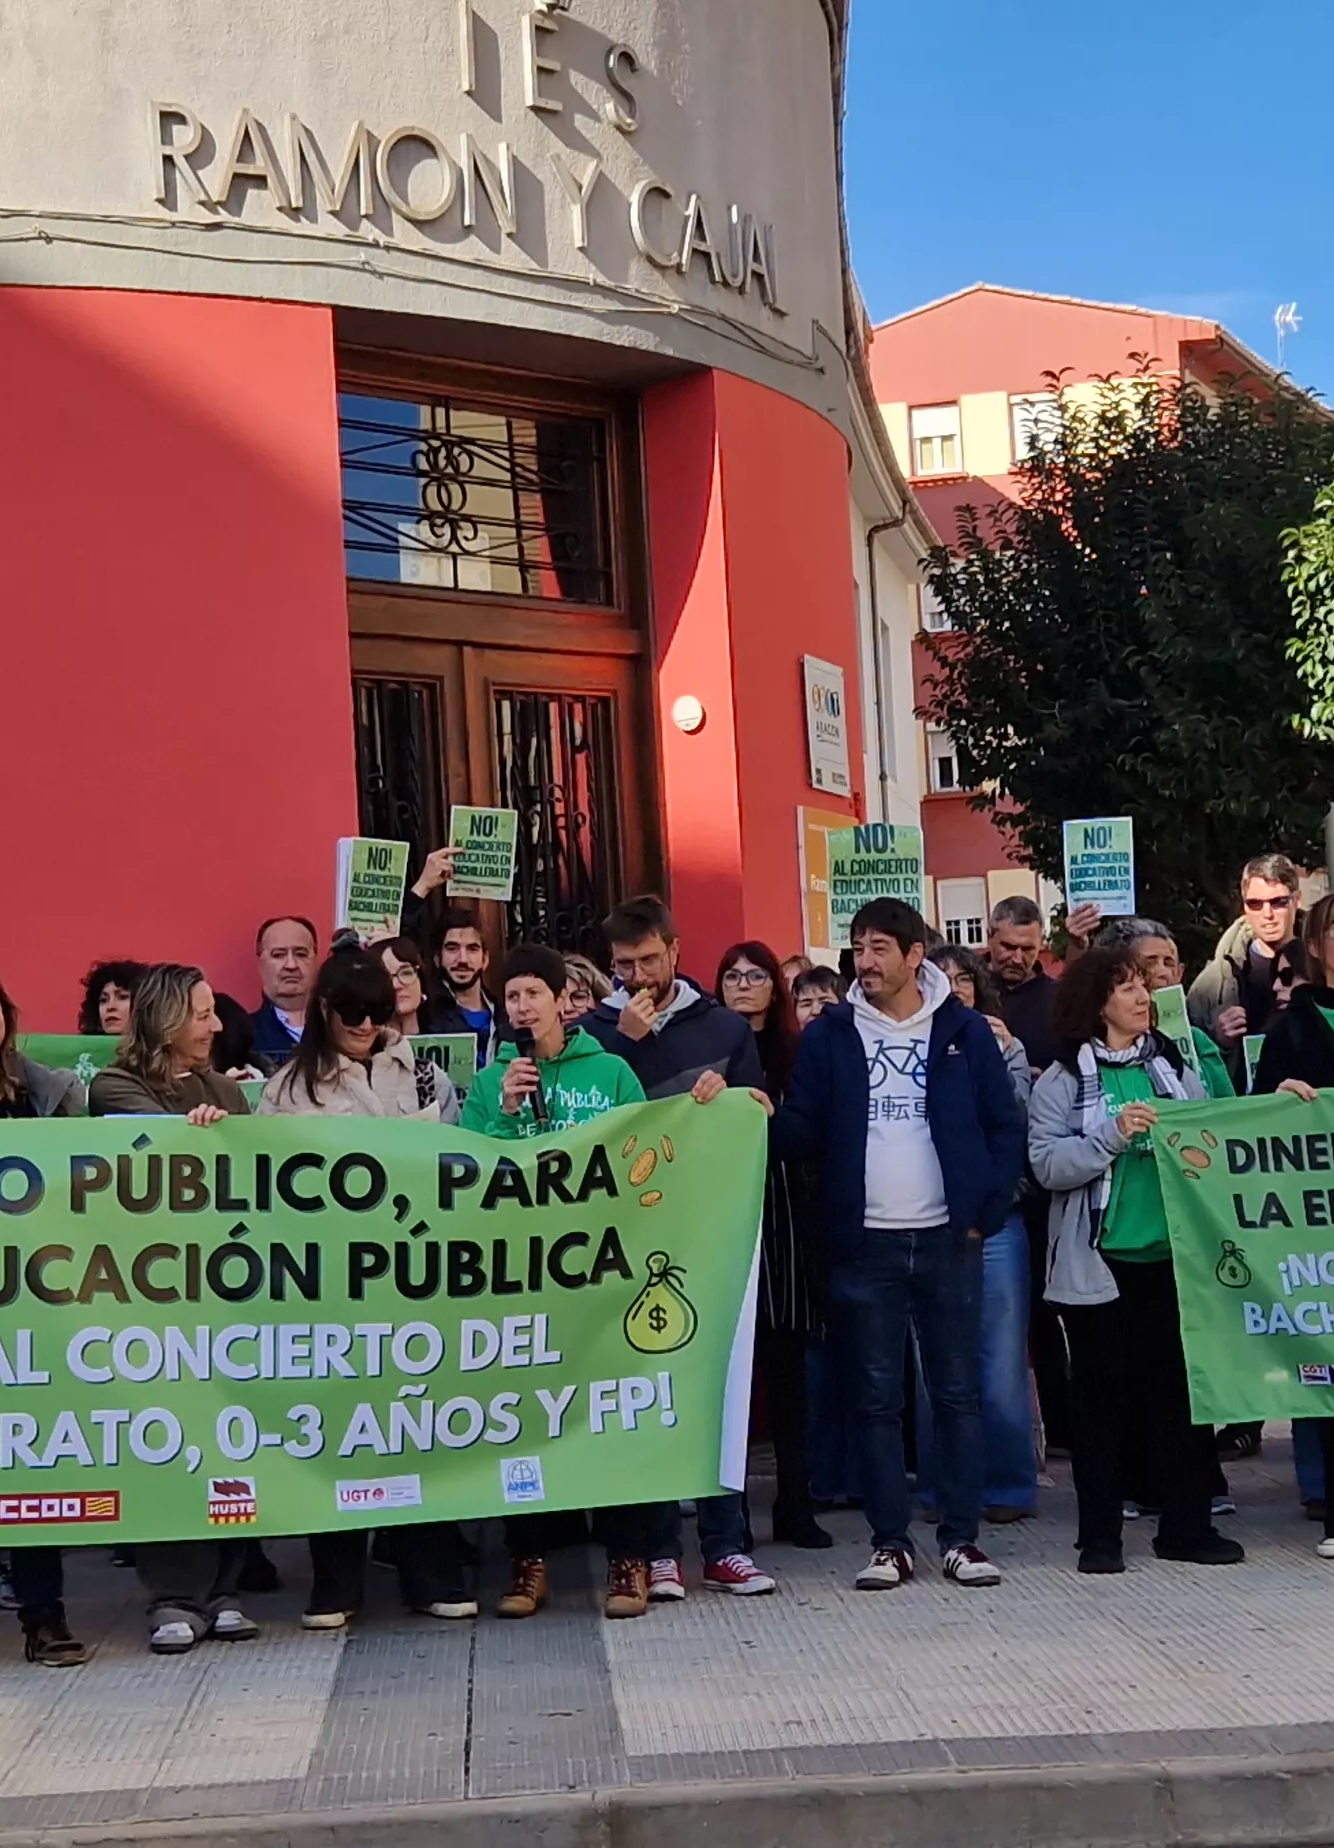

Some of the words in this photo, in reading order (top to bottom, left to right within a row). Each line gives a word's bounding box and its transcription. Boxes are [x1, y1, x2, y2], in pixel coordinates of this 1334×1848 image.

[459, 0, 641, 133] IES
[149, 101, 517, 236] RAMON
[551, 152, 600, 249] Y
[628, 178, 788, 315] CAJAL
[470, 814, 499, 839] NO!
[853, 823, 895, 854] NO!
[1083, 826, 1113, 849] NO!
[367, 846, 393, 872] NO!
[466, 840, 513, 853] CONCIERTO
[1081, 852, 1130, 864] CONCIERTO
[833, 859, 847, 876] AL
[850, 858, 920, 876] CONCIERTO
[833, 878, 901, 895] EDUCATIVO
[903, 877, 920, 894] EN
[69, 1132, 411, 1223] PÚBLICO,
[437, 1143, 619, 1212] PARA
[1233, 1192, 1289, 1229] LA
[348, 1220, 634, 1301] PÚBLICA
[67, 1322, 446, 1384] CONCIERTO
[459, 1313, 562, 1372] DEL
[216, 1403, 325, 1462] 0-3
[336, 1385, 524, 1458] AÑOS
[533, 1386, 579, 1439] Y
[588, 1371, 677, 1435] FP!
[209, 1502, 255, 1515] HUSTE
[340, 1489, 370, 1502] UGT
